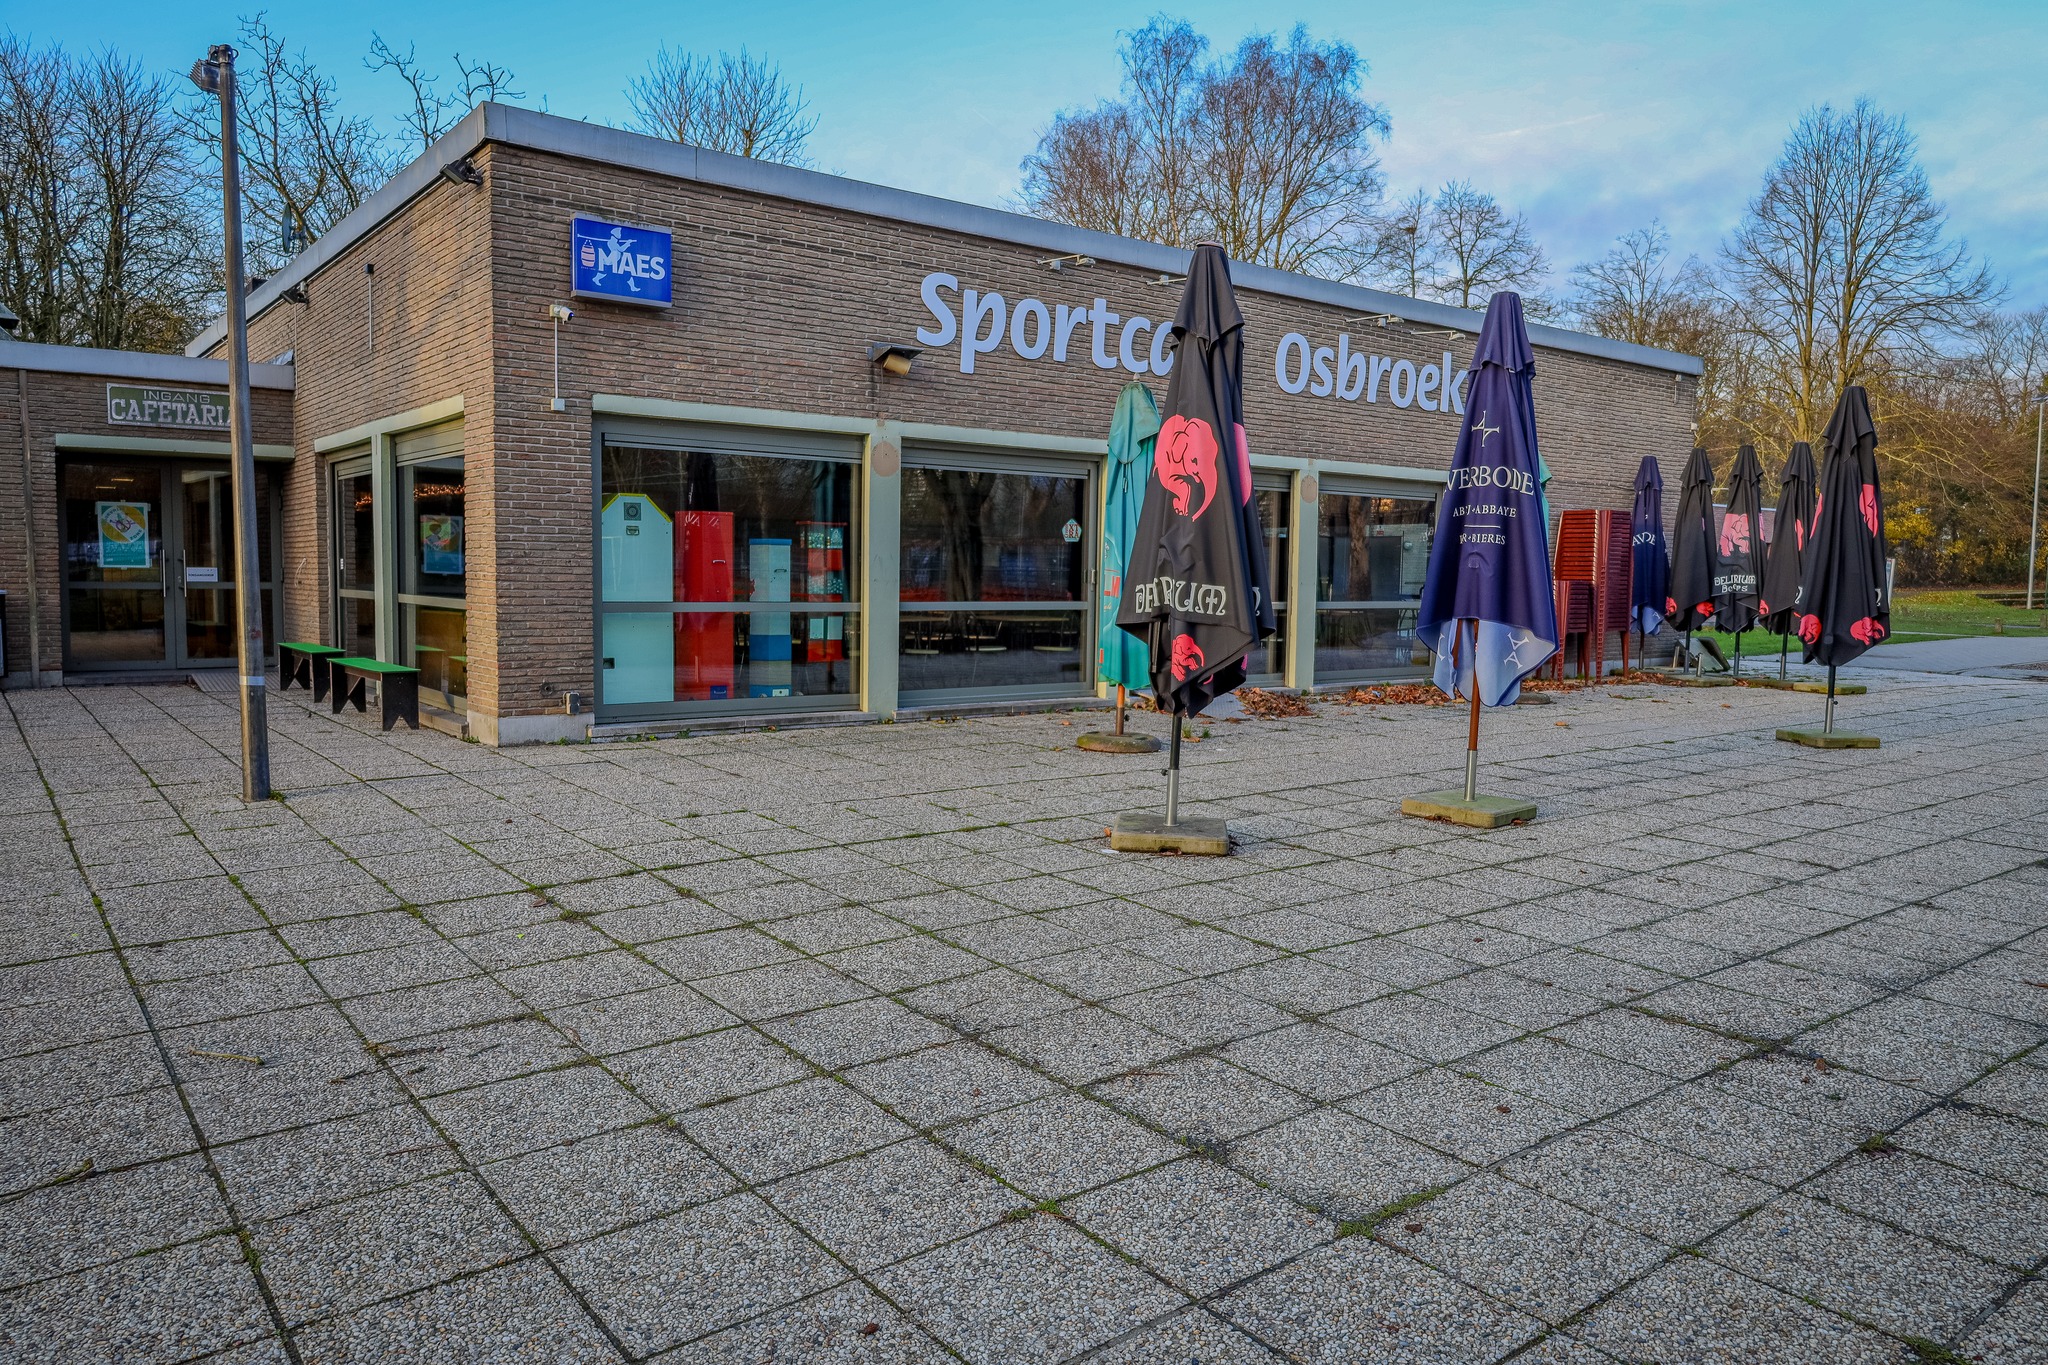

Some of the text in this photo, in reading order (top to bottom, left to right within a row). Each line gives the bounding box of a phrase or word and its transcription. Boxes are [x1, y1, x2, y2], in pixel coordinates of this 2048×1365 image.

[598, 248, 666, 280] MAES
[916, 272, 1468, 415] Sportca Osbroek
[143, 390, 211, 404] INGANG
[111, 398, 231, 426] CAFETARI
[1443, 466, 1534, 499] VERBODE
[1475, 504, 1517, 518] ABBAYE
[1471, 533, 1506, 545] BIERES
[1714, 574, 1756, 586] DELIRIUM
